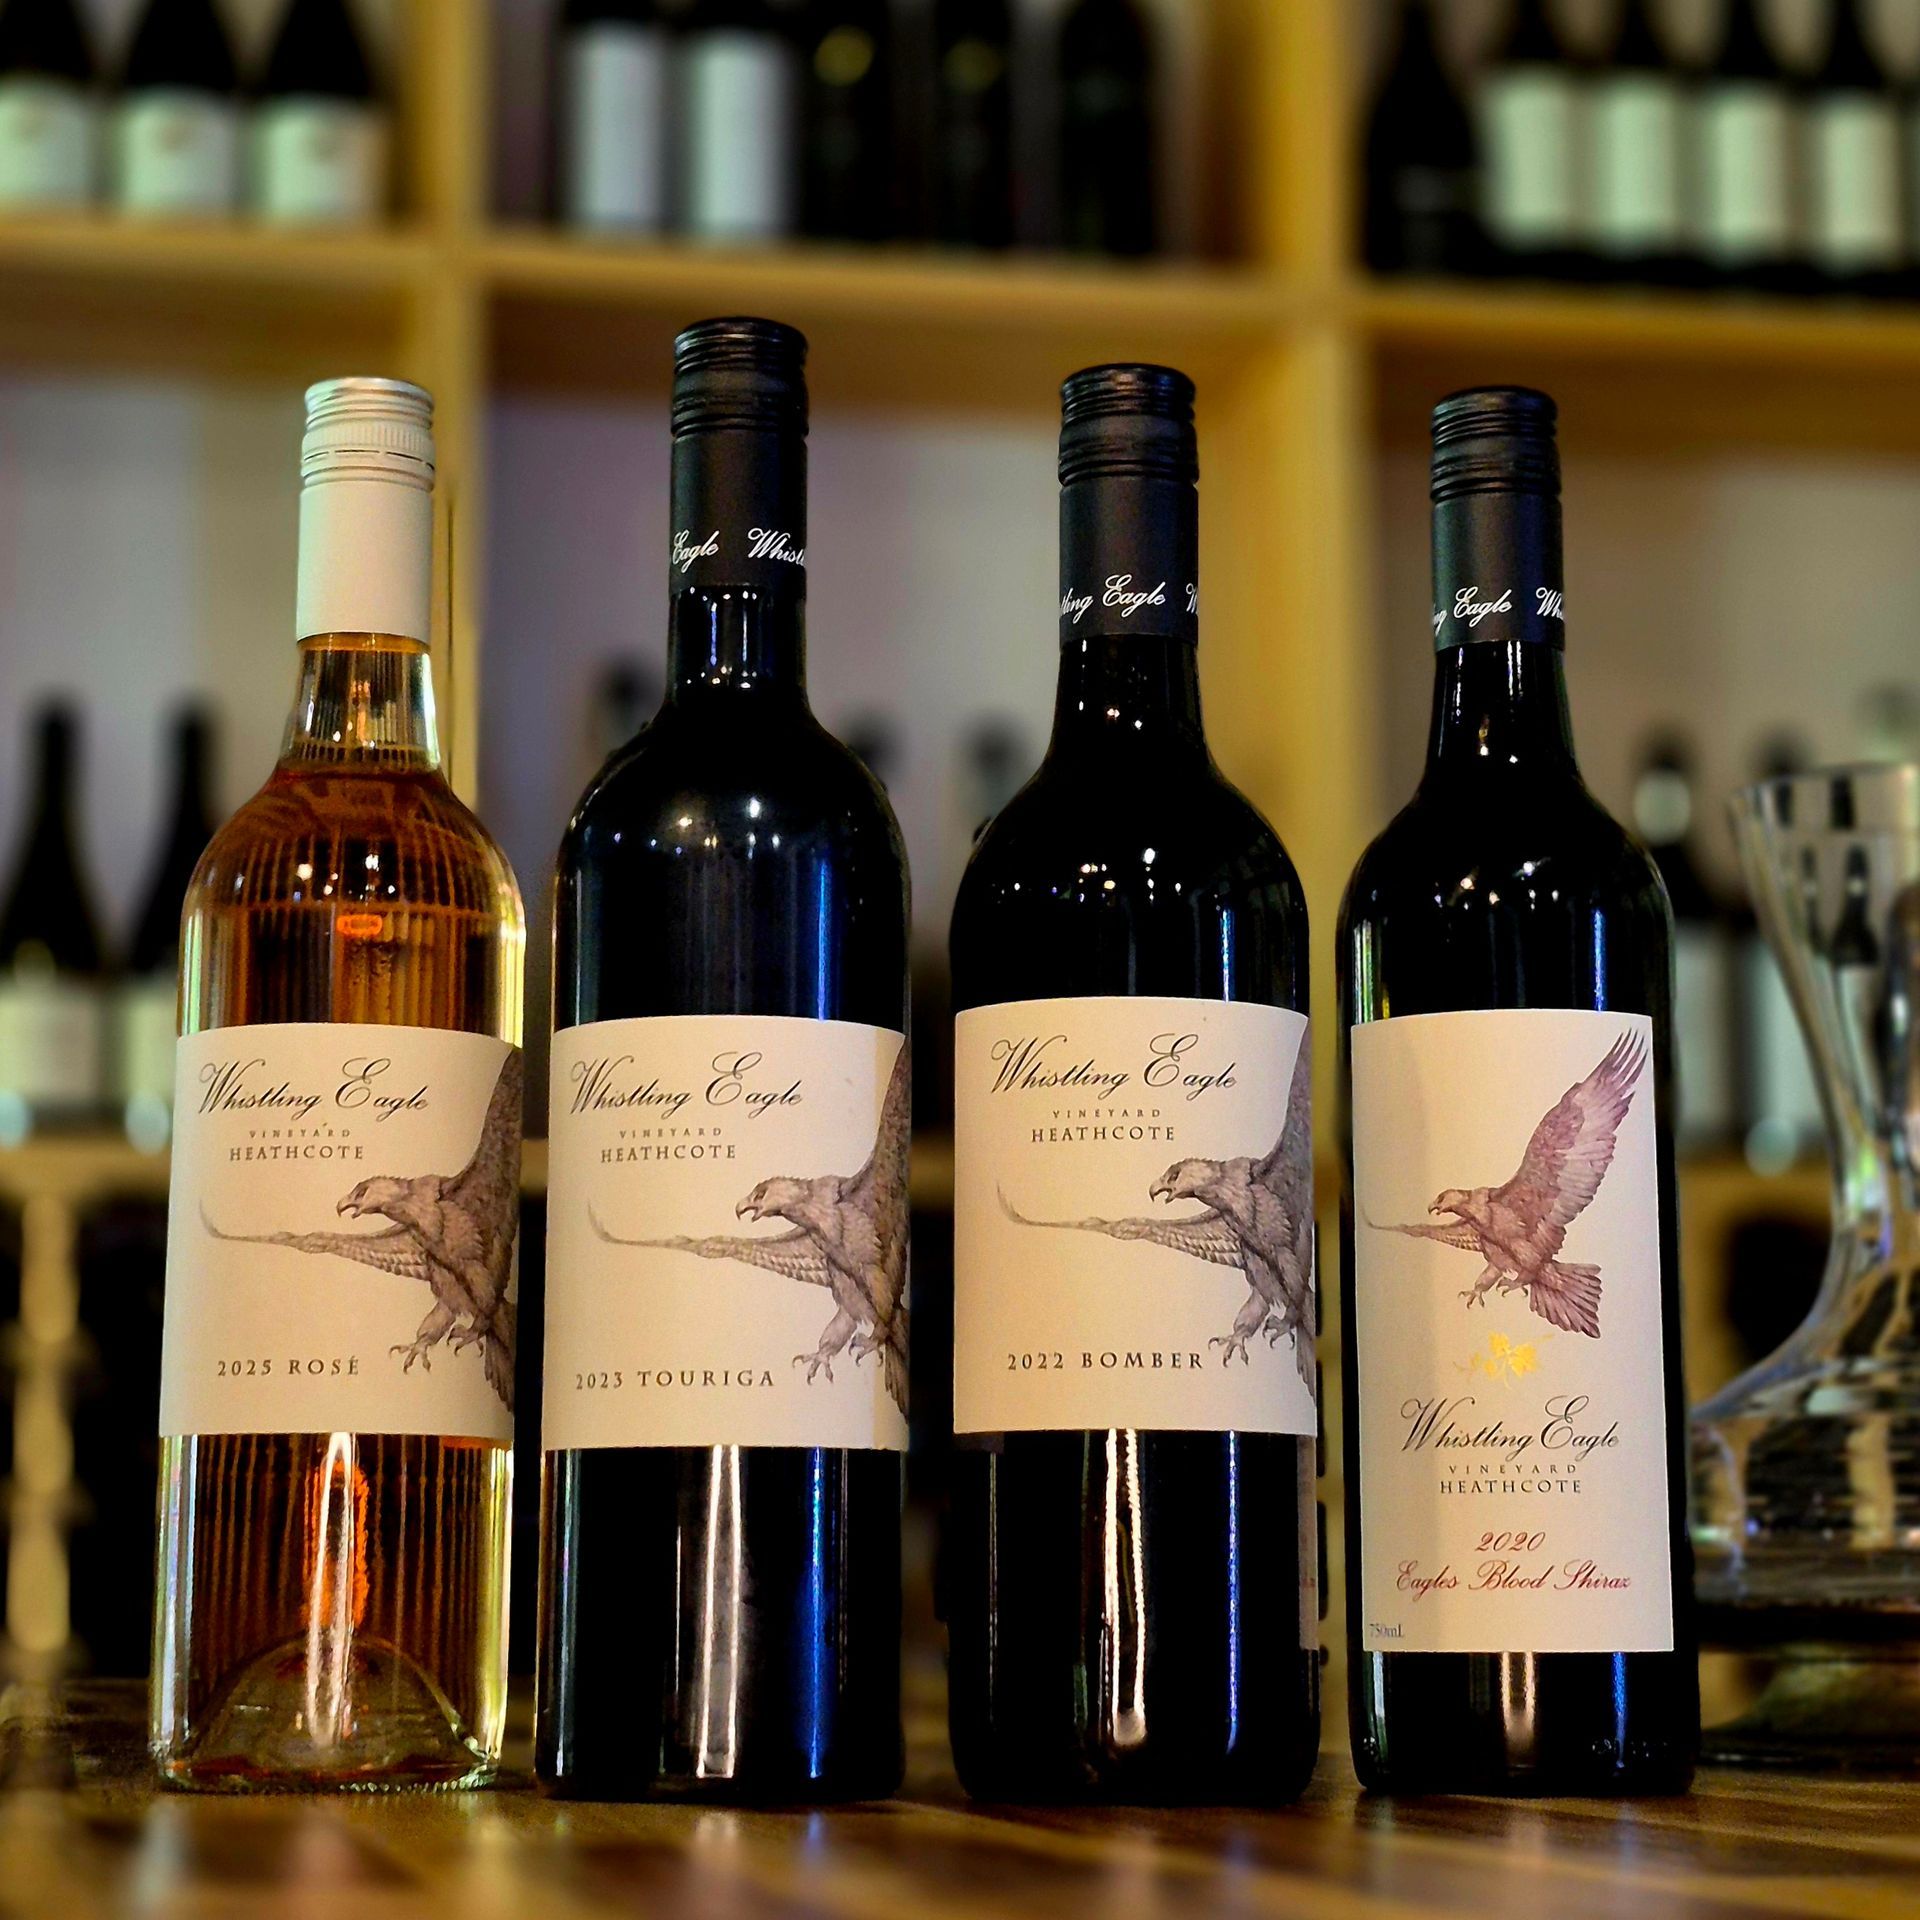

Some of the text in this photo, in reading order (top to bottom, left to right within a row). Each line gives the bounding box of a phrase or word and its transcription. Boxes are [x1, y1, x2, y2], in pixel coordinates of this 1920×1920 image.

[672, 529, 720, 573] Eagle
[1102, 573, 1166, 618] Eagle
[1453, 586, 1513, 628] Eagle
[991, 1032, 1237, 1101] Whistling Eagle
[198, 1056, 430, 1122] Whistling Eagle
[569, 1051, 803, 1120] Whistling Eagle
[1052, 1108, 1161, 1119] VINEYARD
[248, 1128, 352, 1139] VINEYARD
[619, 1127, 723, 1139] VINEYARD
[1031, 1125, 1176, 1143] HEATHCOTE
[229, 1144, 365, 1162] HEATHCOTE
[600, 1144, 737, 1164] HEATHCOTE
[217, 1354, 360, 1377] 2025 ROSÉ
[1007, 1351, 1204, 1370] 2022 BOMBER
[575, 1370, 775, 1390] 2023 TOURIGA
[1400, 1394, 1620, 1462] Whistling Eagle
[1448, 1463, 1577, 1474] VINEYARD
[1440, 1479, 1582, 1494] HEATHCOTE
[1474, 1531, 1546, 1552] 2020
[1396, 1558, 1631, 1602] Eagles Blood Shiraz
